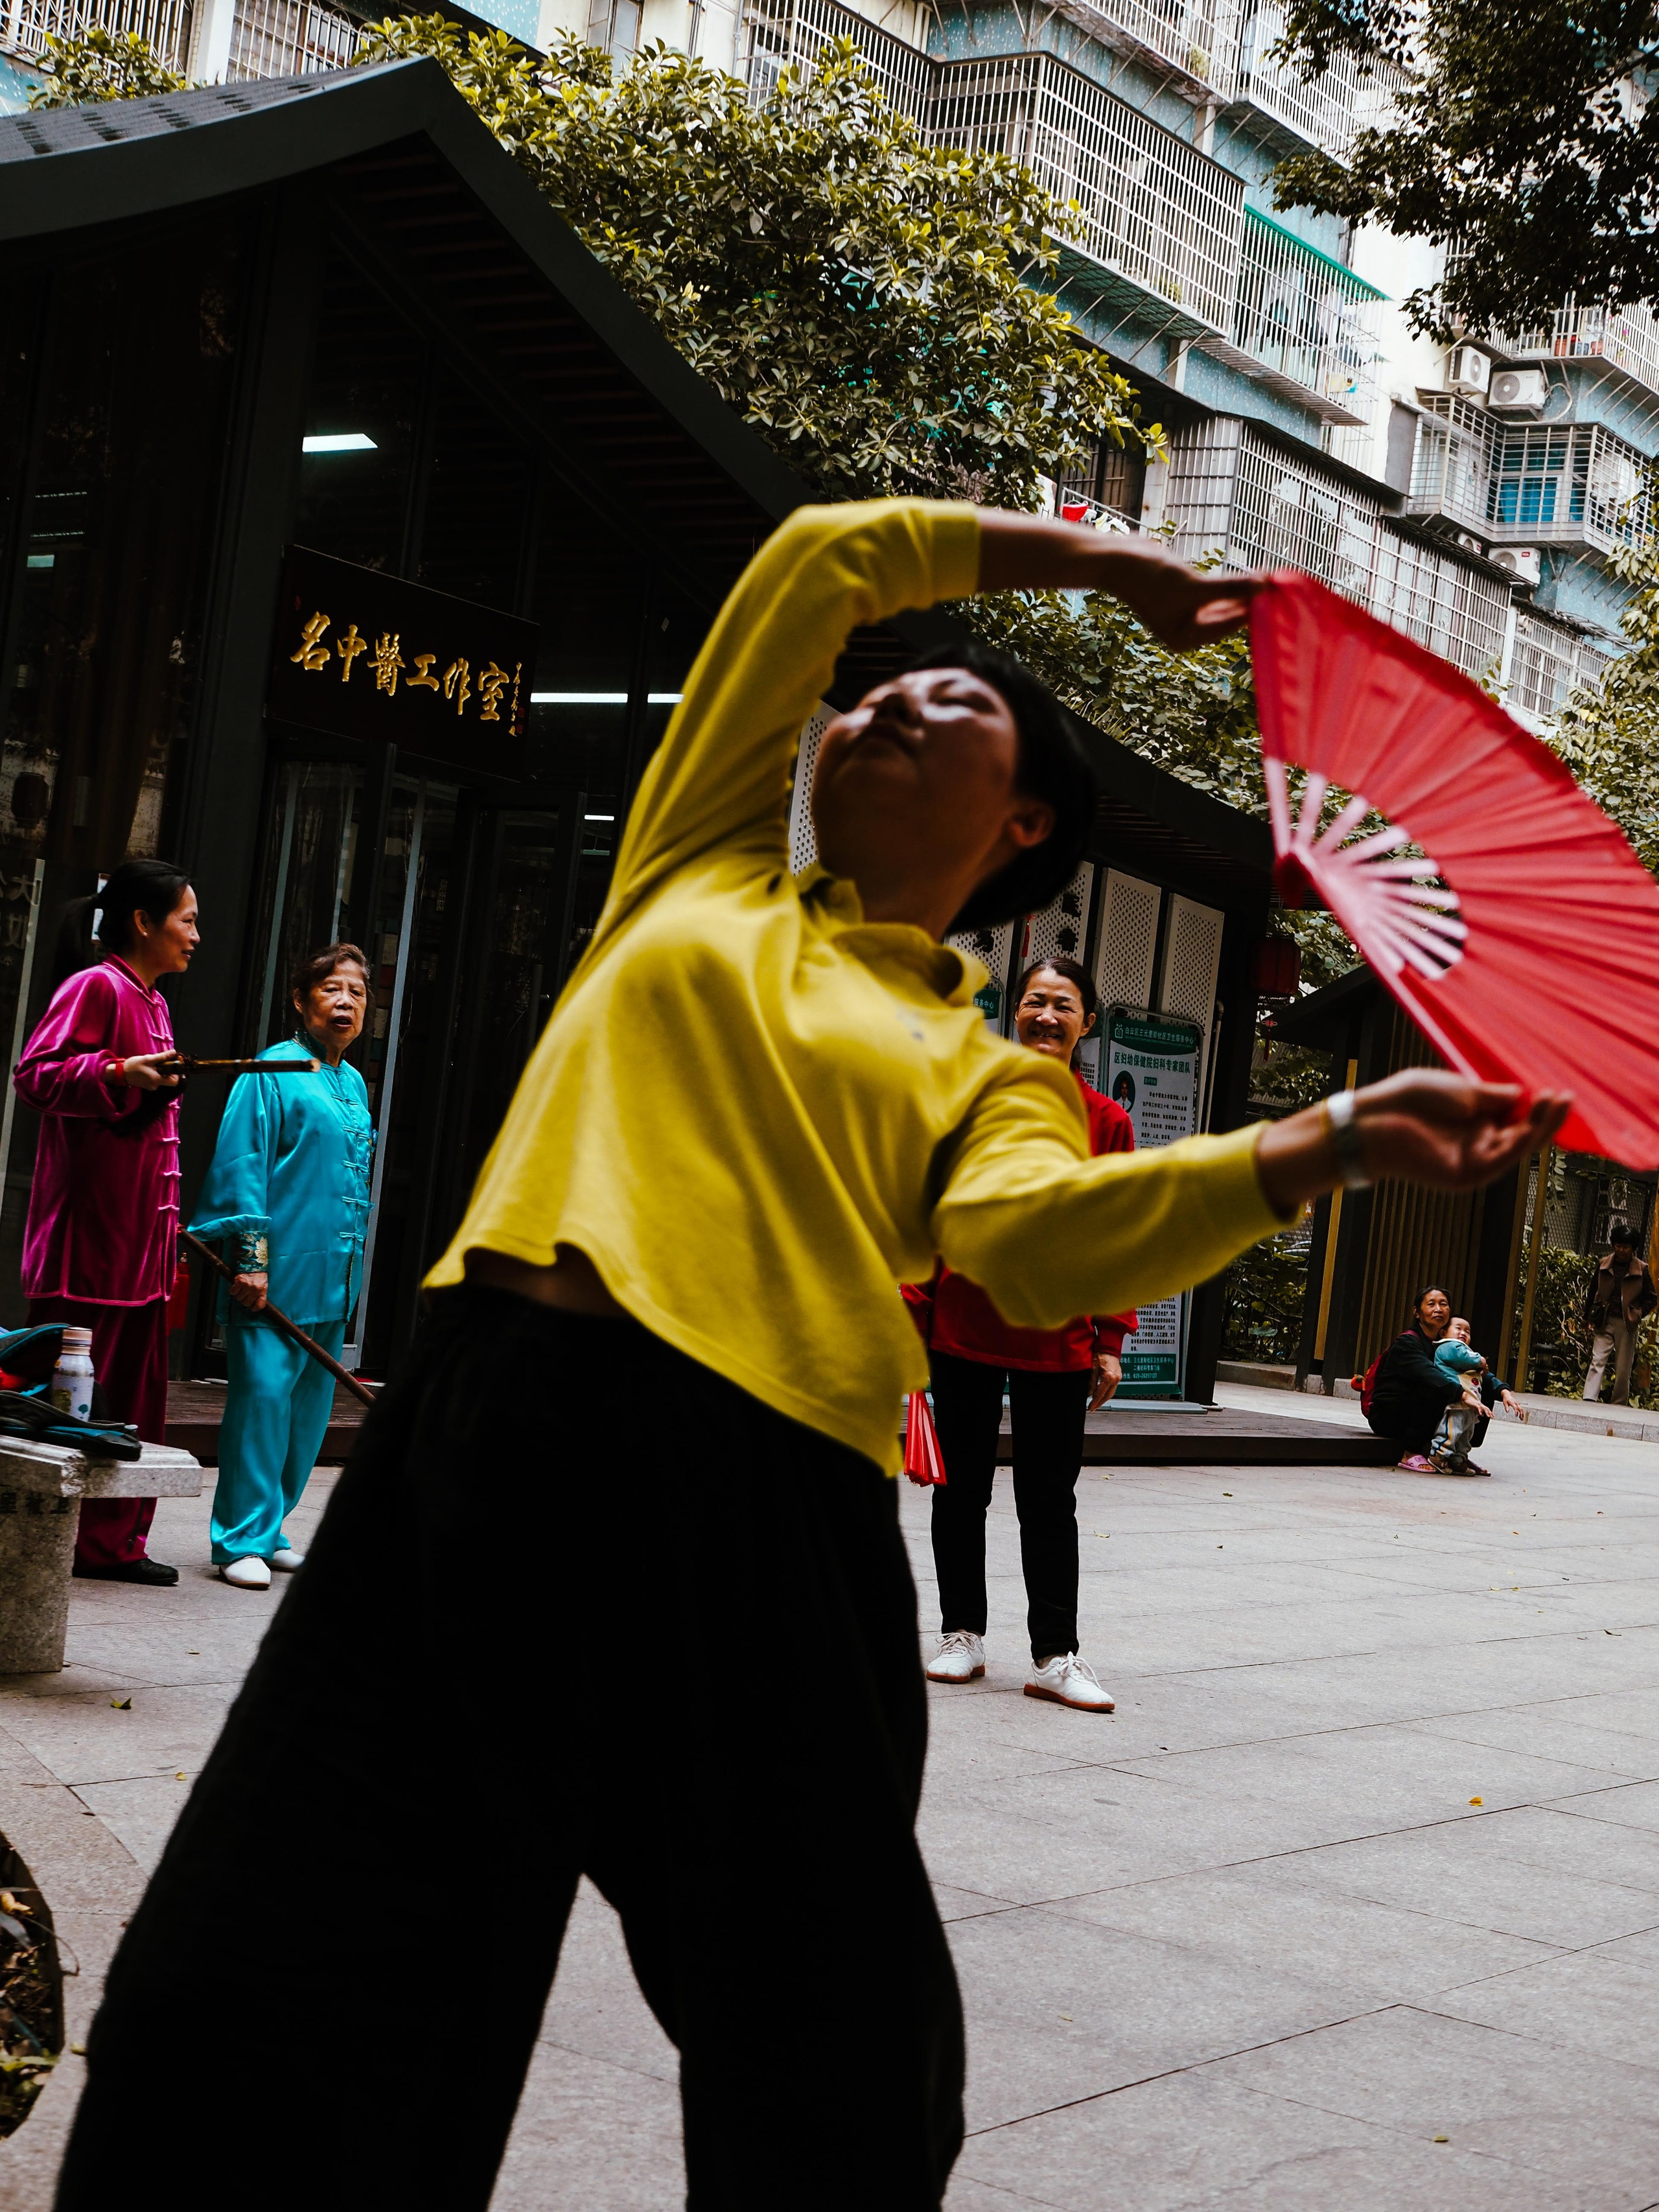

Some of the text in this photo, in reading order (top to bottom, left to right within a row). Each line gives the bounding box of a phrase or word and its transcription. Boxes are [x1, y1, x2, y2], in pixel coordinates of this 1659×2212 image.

[972, 997, 994, 1009] 服务中心
[1125, 1027, 1194, 1044] 白云区三元里街社区卫生服务中心
[1114, 1052, 1190, 1073] 区妇幼保健院妇科专家团队
